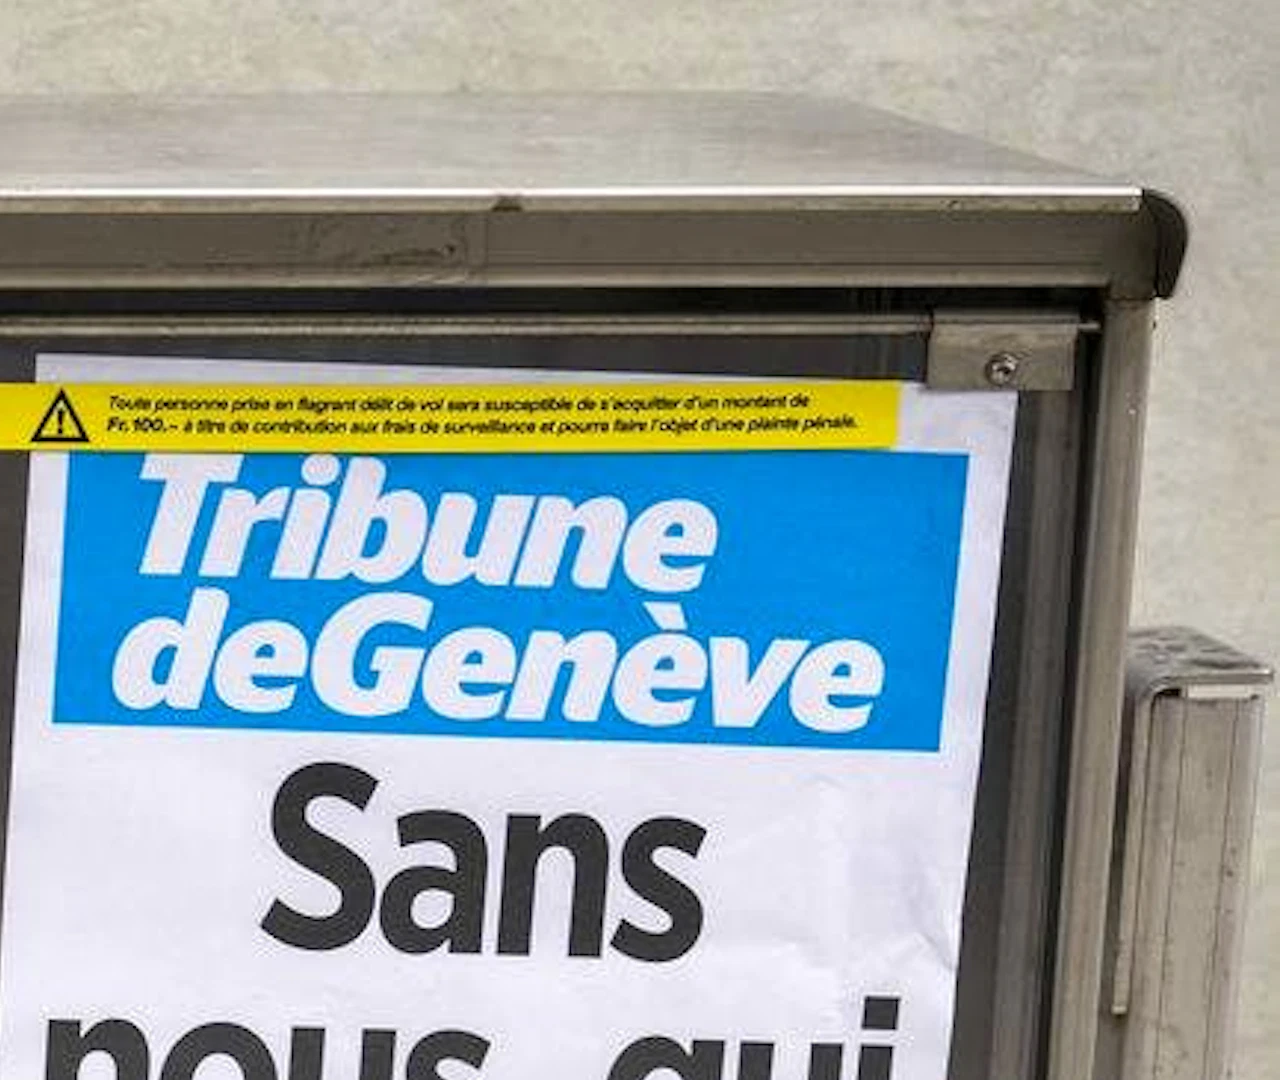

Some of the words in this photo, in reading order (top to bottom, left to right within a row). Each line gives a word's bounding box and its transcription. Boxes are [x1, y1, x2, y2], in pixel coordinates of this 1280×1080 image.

[107, 416, 128, 432] Fr.
[184, 419, 194, 432] à
[197, 419, 225, 433] titre
[230, 419, 249, 433] de
[253, 419, 347, 433] contribution
[351, 423, 379, 433] aux
[383, 420, 415, 433] frais
[420, 420, 439, 433] de
[444, 420, 536, 433] surveillance
[540, 421, 554, 432] et
[556, 422, 609, 437] pourra
[613, 419, 647, 432] faire
[651, 418, 698, 434] l'objet
[702, 418, 744, 431] d'une
[749, 417, 799, 433] plainte
[802, 415, 857, 432] pénale.
[111, 397, 151, 411] Toute
[155, 399, 228, 414] personne
[231, 399, 269, 414] prise
[275, 400, 293, 411] en
[297, 397, 356, 414] flagrant
[361, 398, 390, 411] délit
[395, 398, 416, 411] de
[420, 398, 445, 411] vol
[448, 401, 480, 411] sera
[485, 399, 571, 414] susceptible
[576, 399, 595, 411] de
[600, 397, 678, 413] s'acquitter
[683, 396, 718, 410] d'un
[722, 396, 786, 409] montant
[790, 394, 810, 408] de
[136, 454, 717, 591] Tribune
[113, 588, 883, 734] deGenève
[261, 763, 706, 962] Sans
